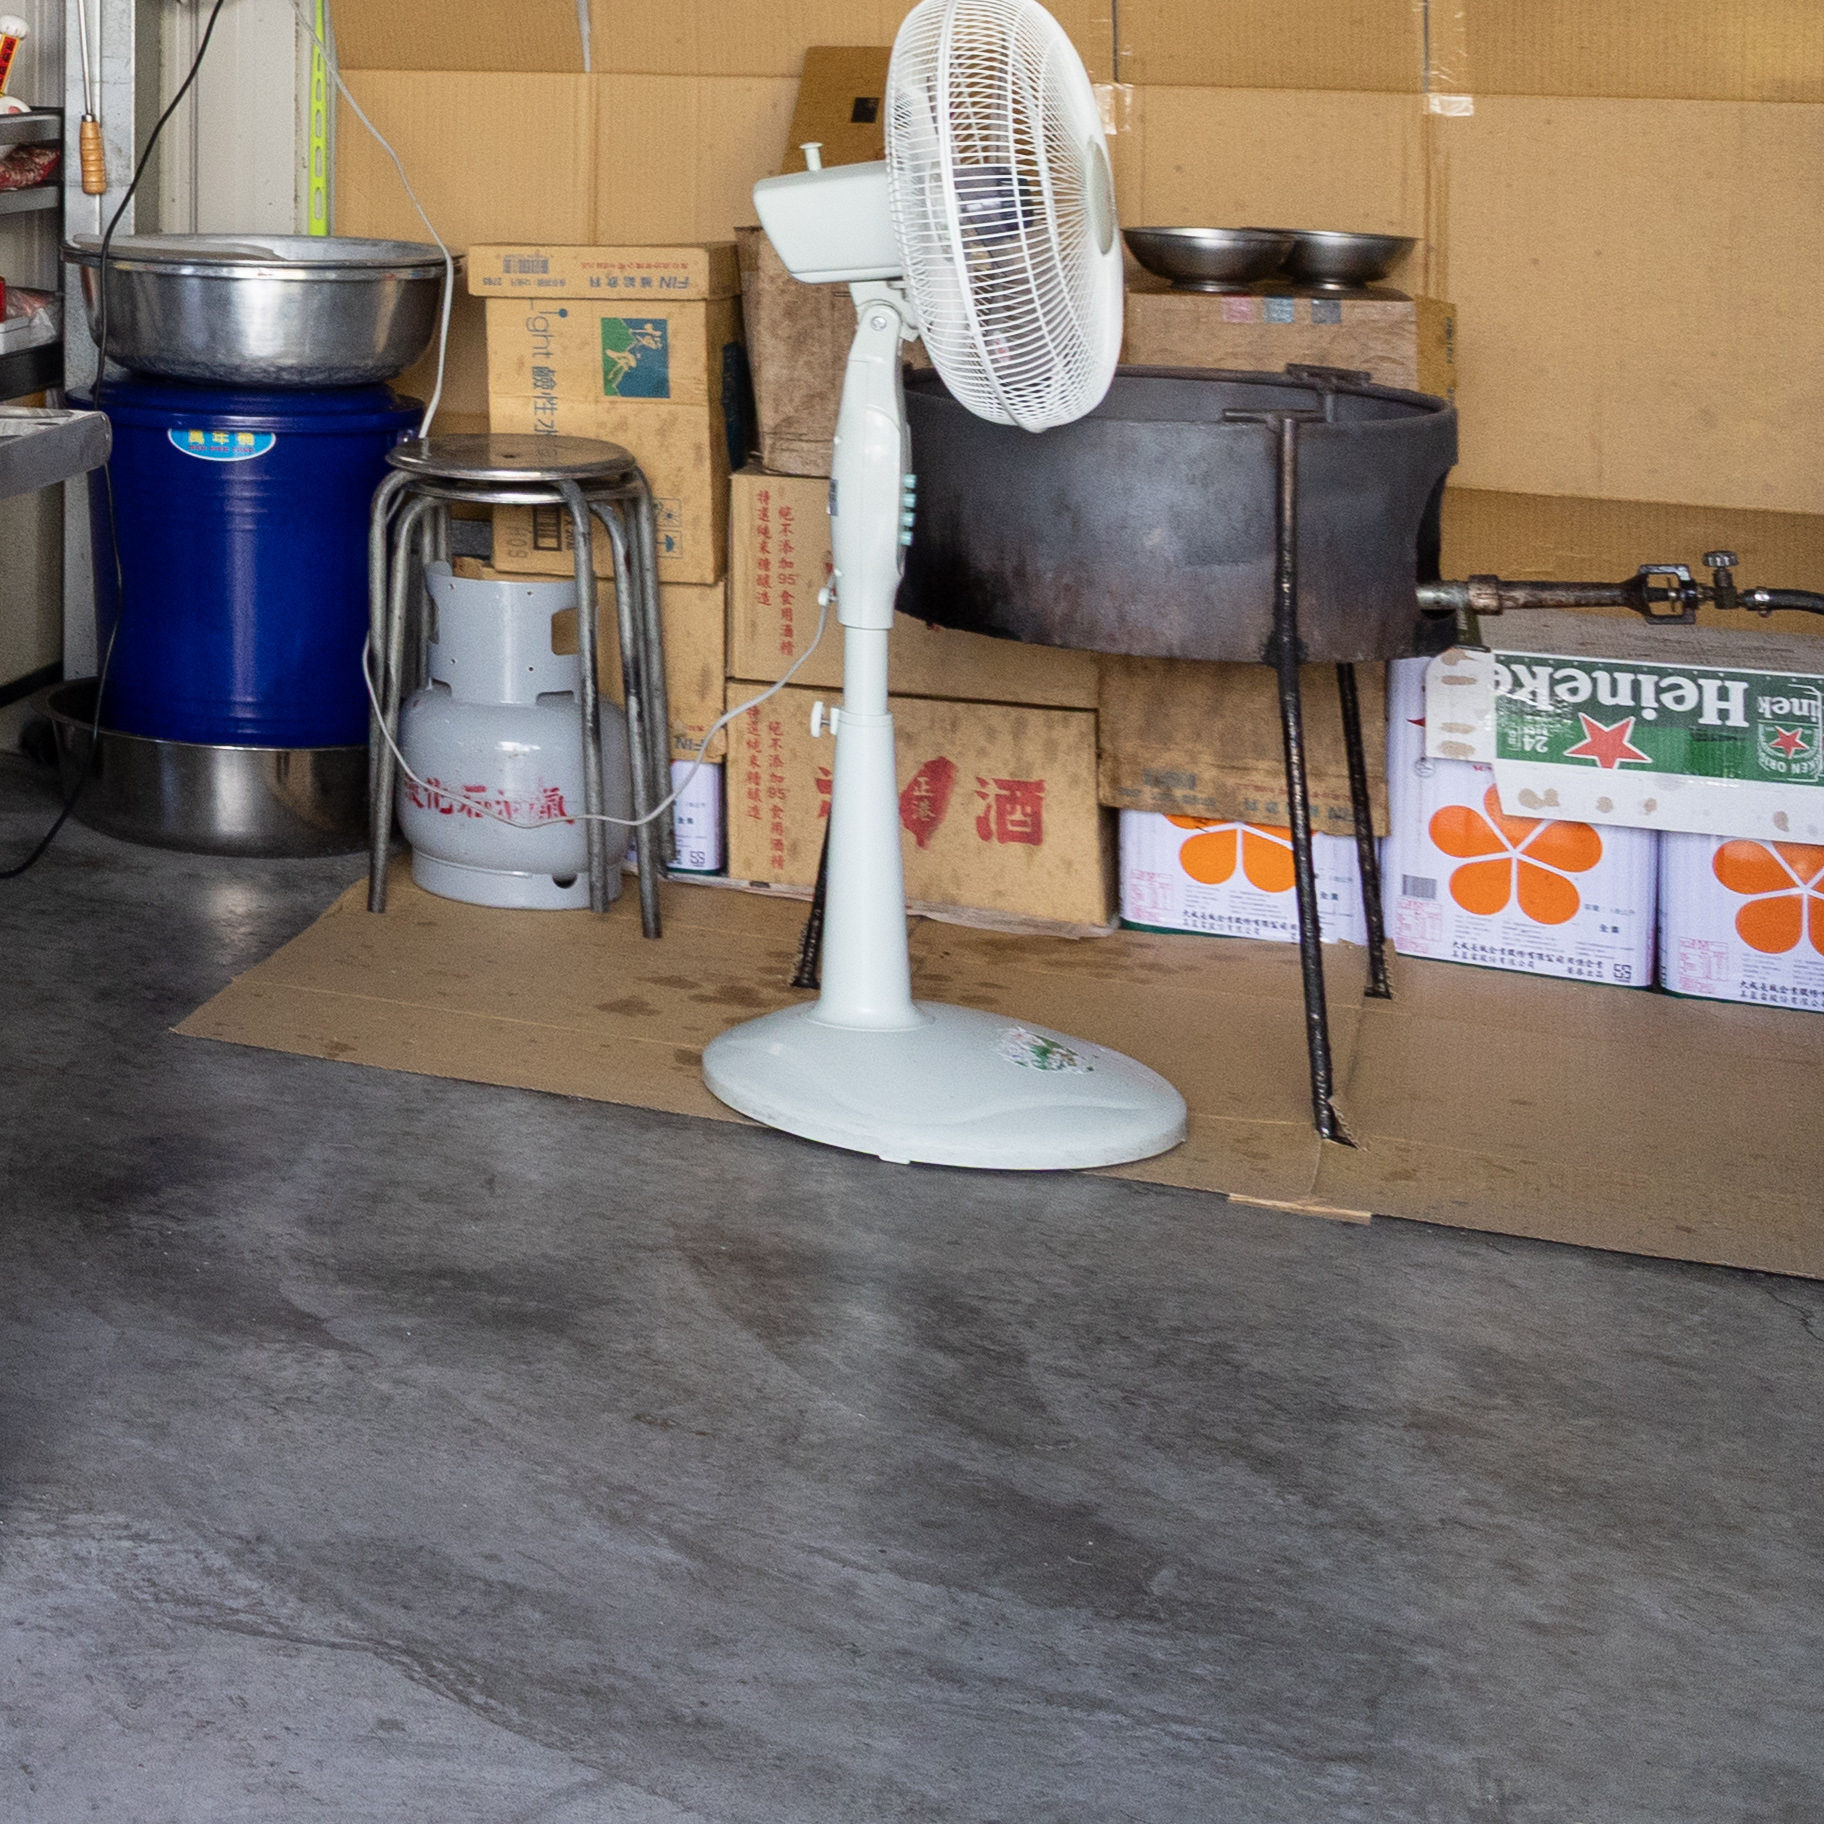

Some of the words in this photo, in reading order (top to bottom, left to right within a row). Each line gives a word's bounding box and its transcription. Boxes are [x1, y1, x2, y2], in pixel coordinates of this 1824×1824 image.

[660, 276, 689, 289] FIN
[1523, 732, 1549, 753] 24
[974, 776, 1046, 847] 酒
